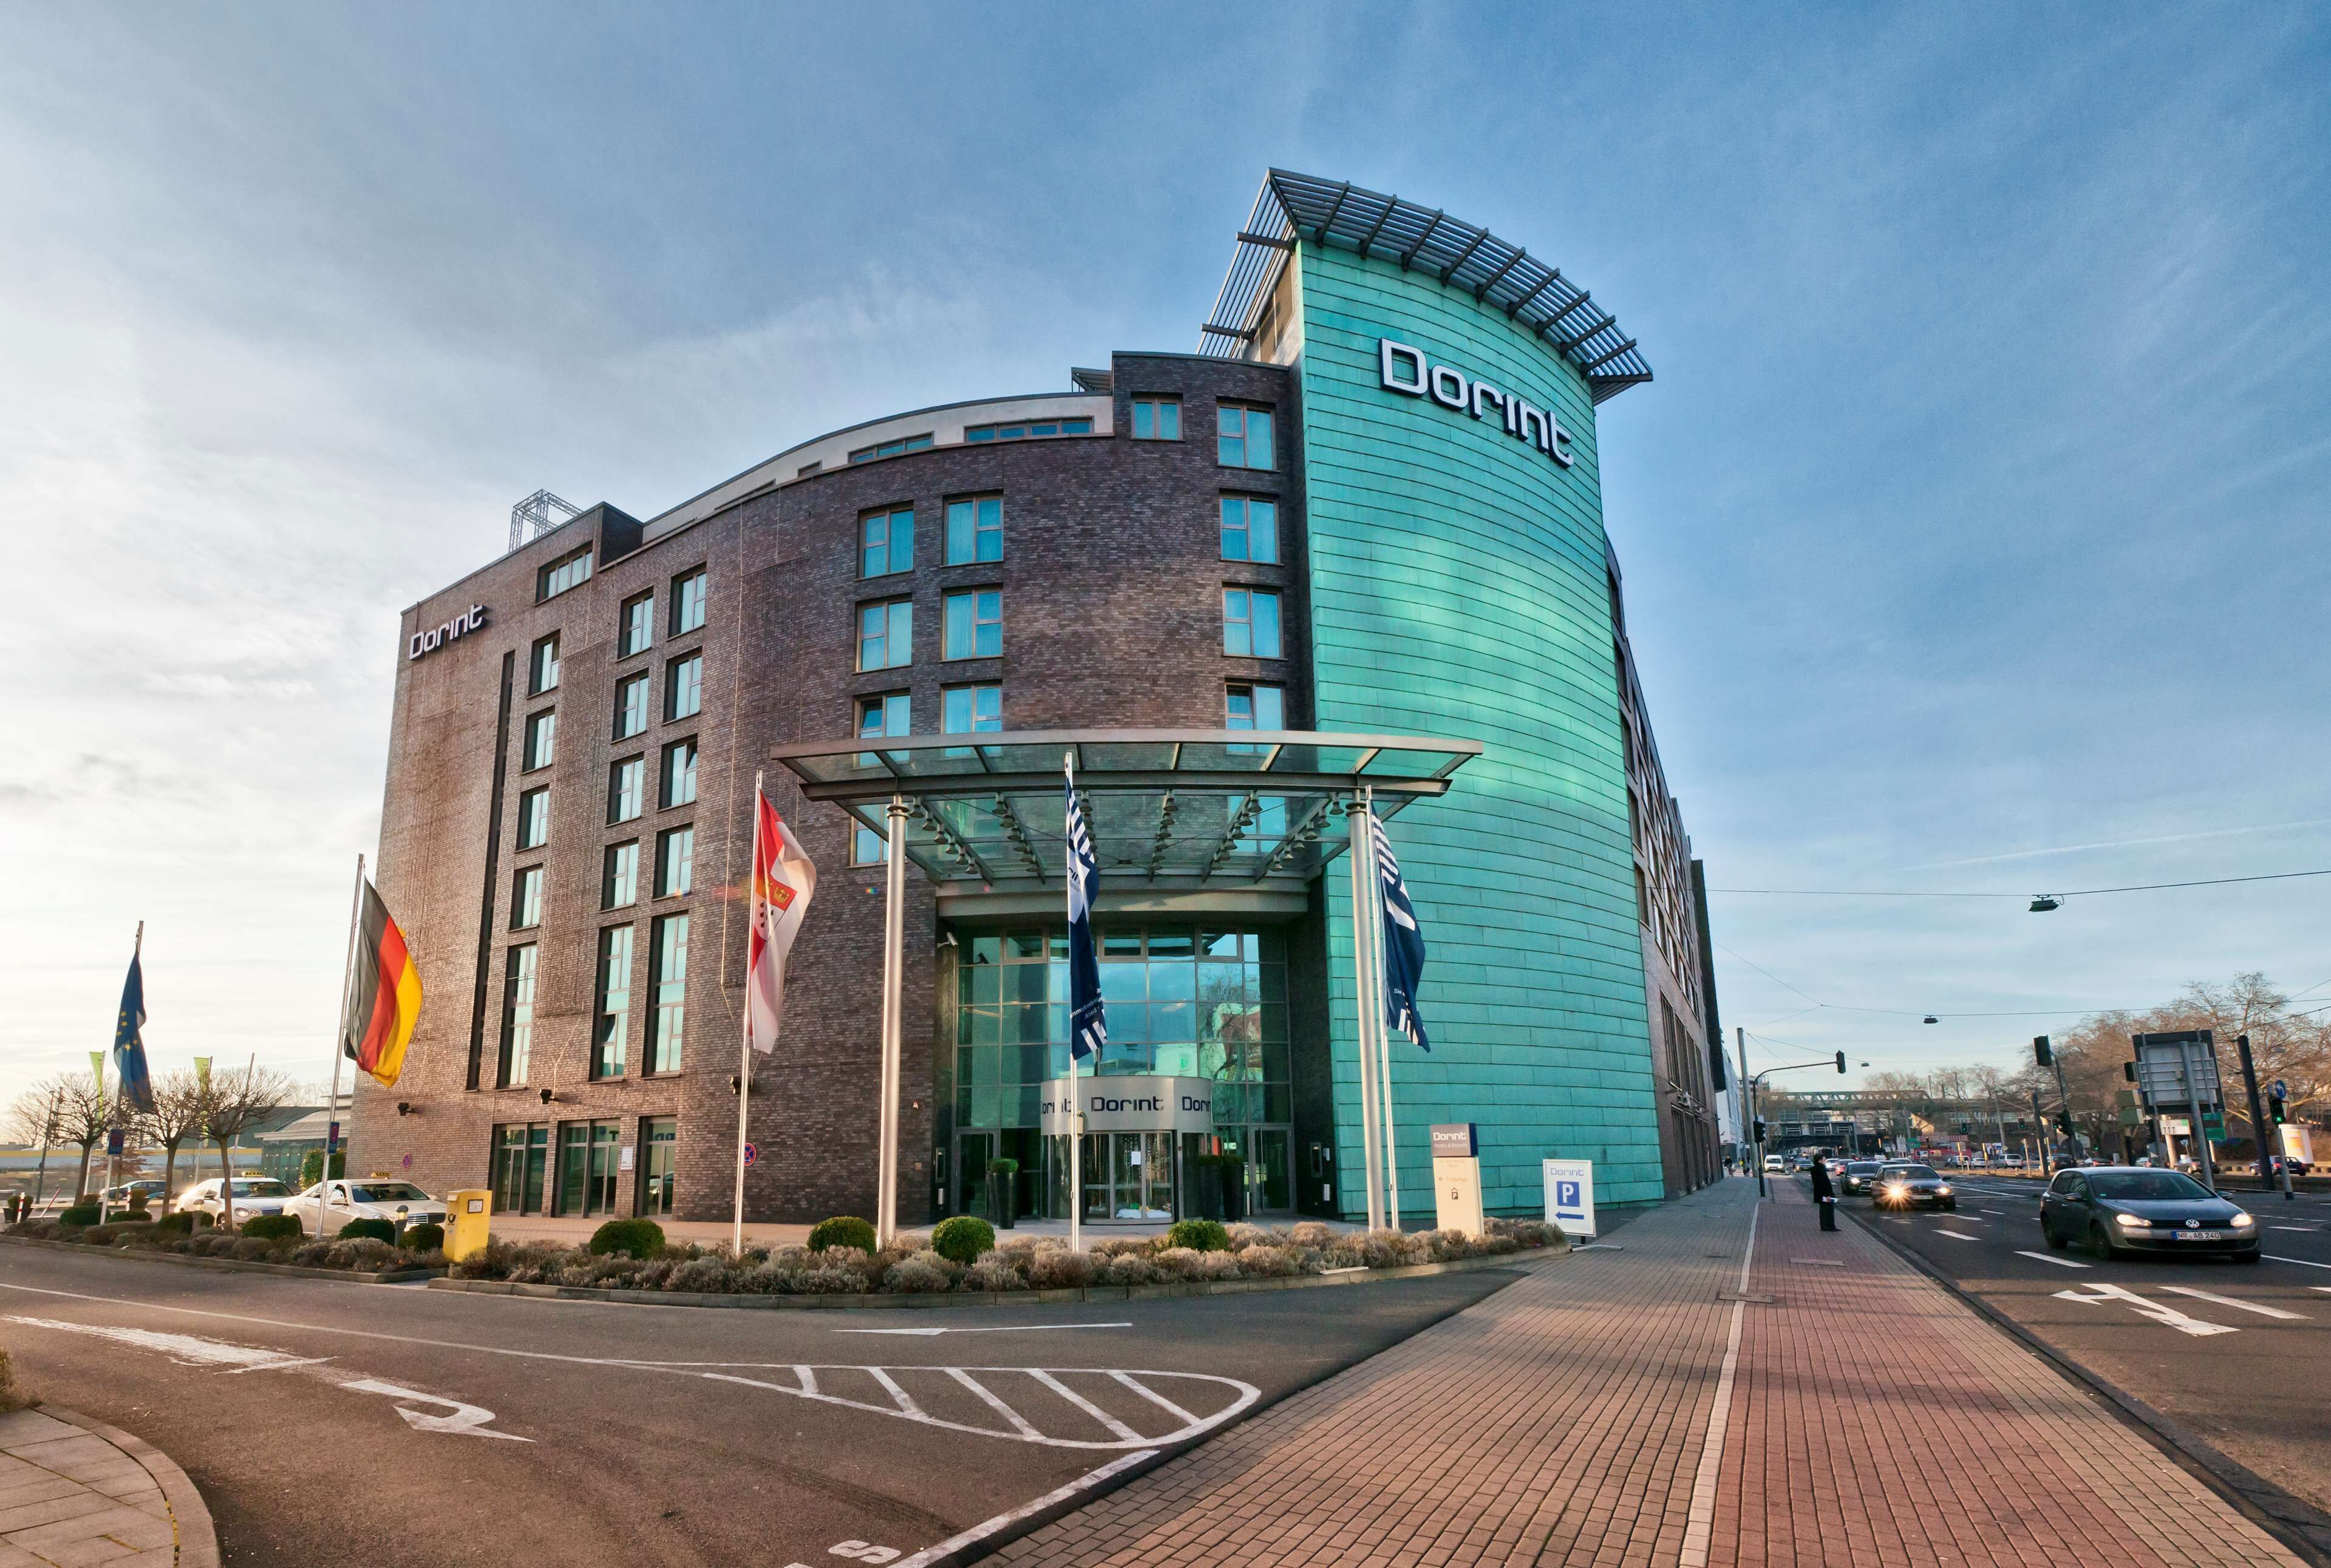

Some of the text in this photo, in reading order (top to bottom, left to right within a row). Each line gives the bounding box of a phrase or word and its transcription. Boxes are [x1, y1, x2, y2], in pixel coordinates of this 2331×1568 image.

[1379, 338, 1574, 468] Dorint
[409, 604, 485, 660] Dorint
[1091, 1096, 1163, 1112] Dorint
[1182, 1096, 1211, 1112] Dorin
[1433, 1132, 1467, 1141] Dorint
[1551, 1167, 1584, 1176] Dorint
[1562, 1184, 1574, 1203] P
